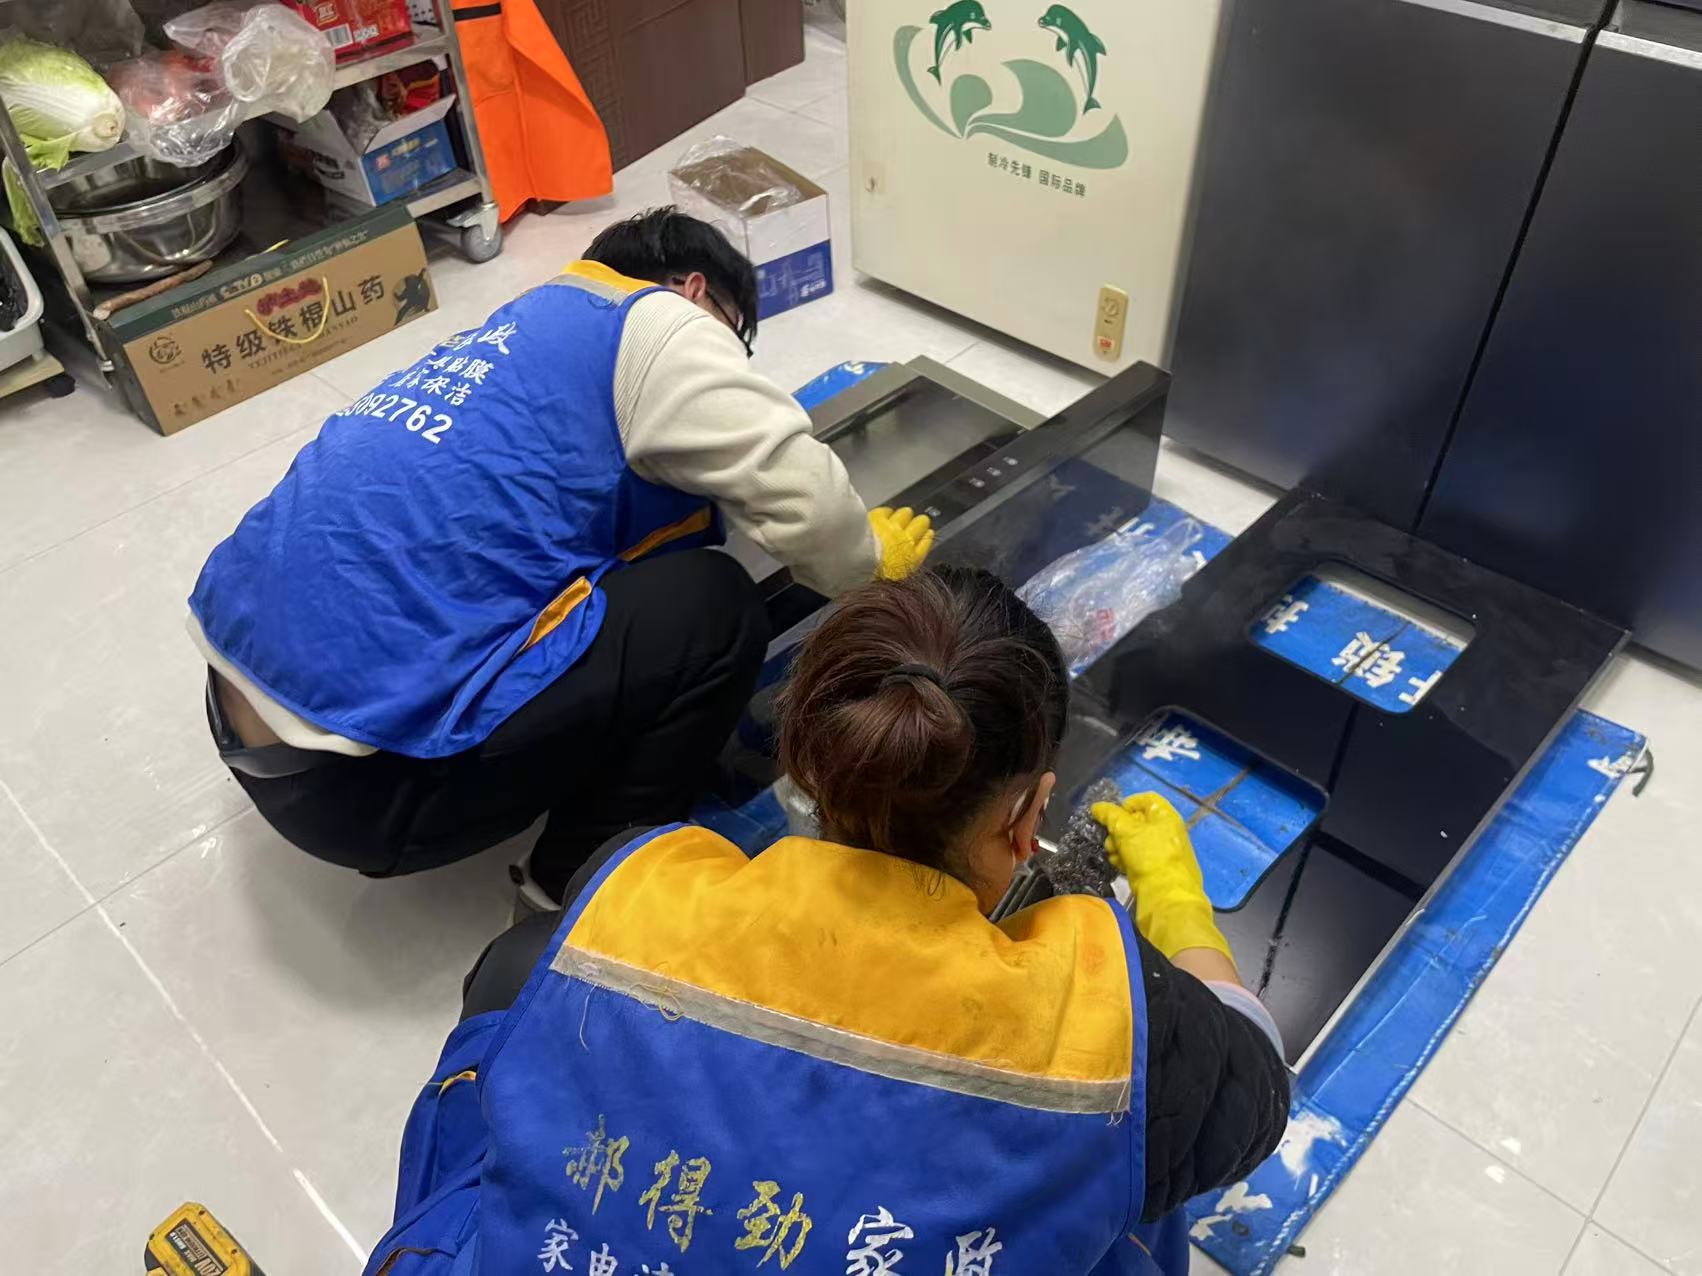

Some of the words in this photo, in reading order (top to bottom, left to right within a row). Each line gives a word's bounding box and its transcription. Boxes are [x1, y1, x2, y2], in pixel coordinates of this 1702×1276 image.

[1039, 169, 1086, 197] 国际品牌
[202, 274, 385, 374] 特级铁棍山药
[336, 392, 454, 445] 092762
[537, 1218, 675, 1276] 家电
